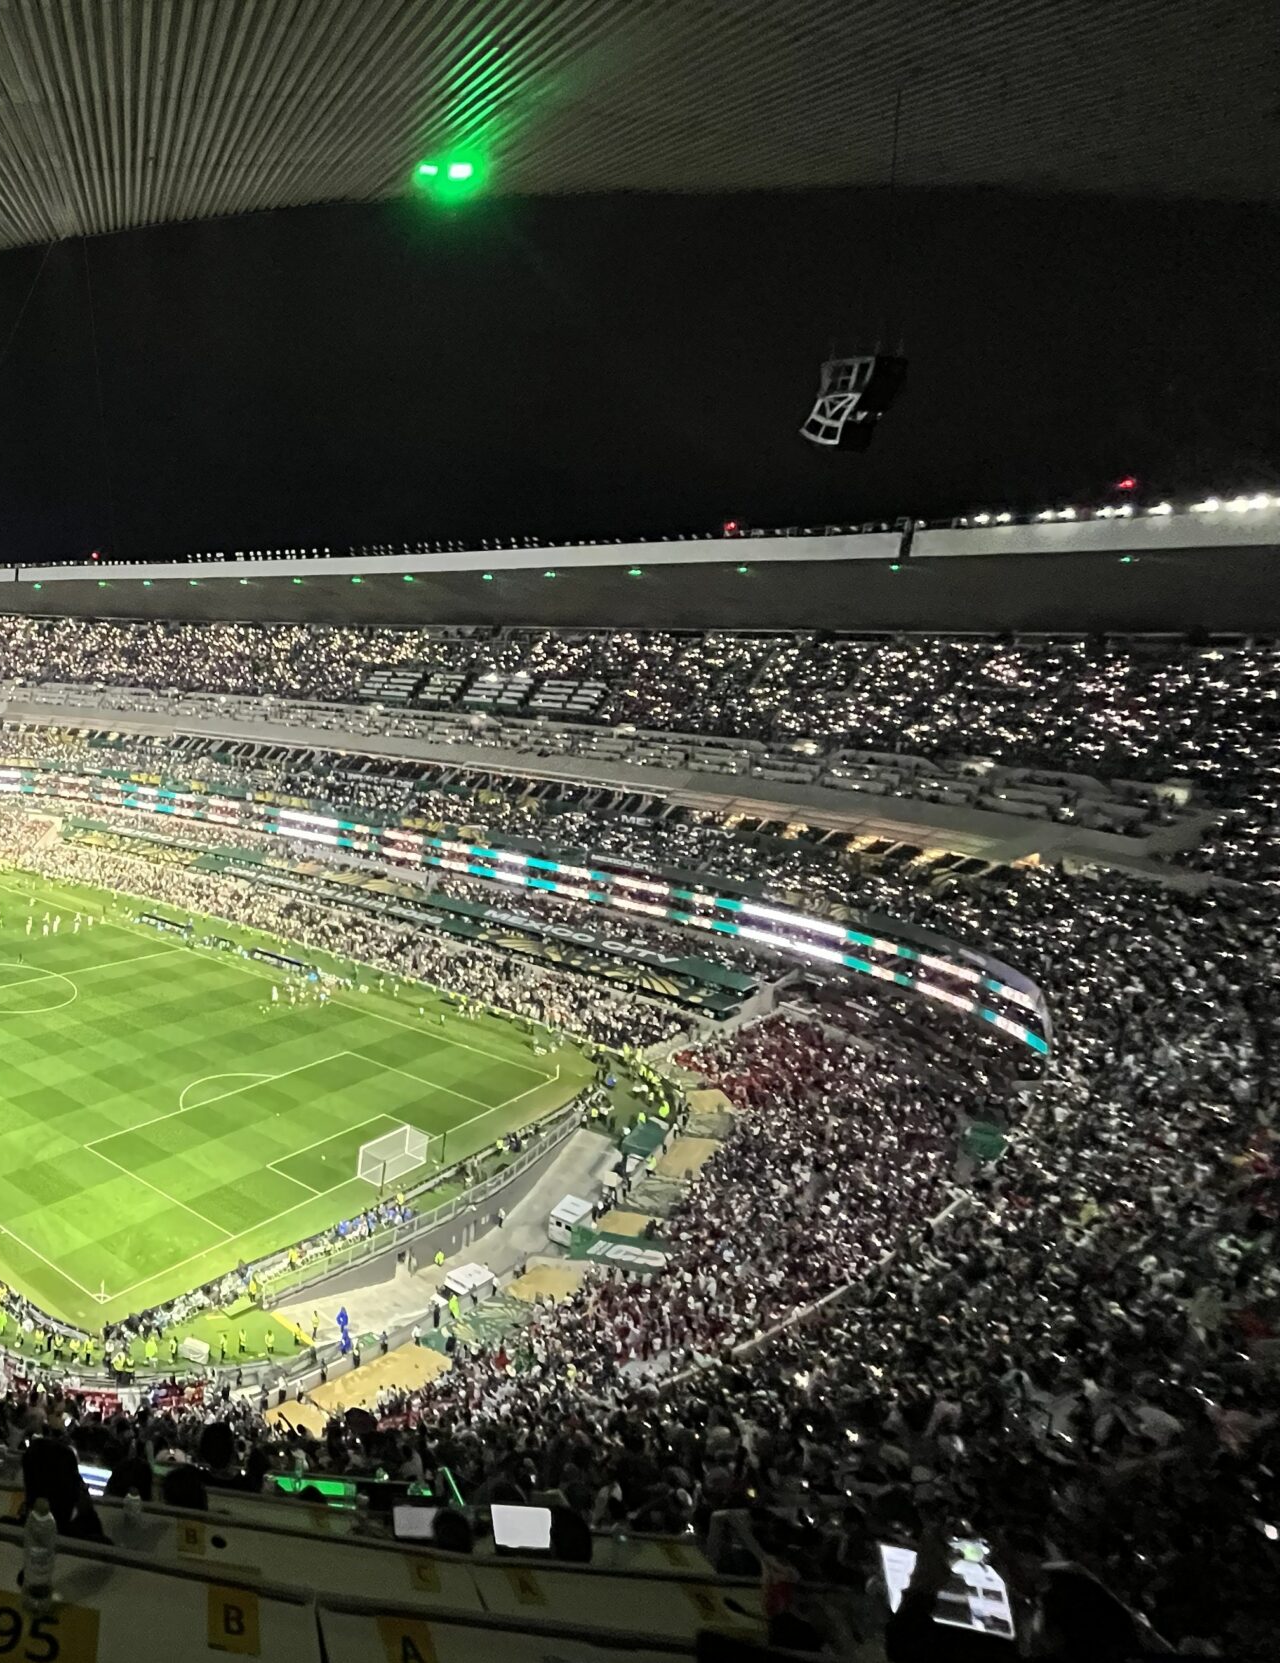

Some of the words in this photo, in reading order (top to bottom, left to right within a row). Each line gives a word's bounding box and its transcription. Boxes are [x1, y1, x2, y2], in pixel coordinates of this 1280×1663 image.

[483, 909, 595, 943] MEXICO
[601, 940, 680, 963] CITY
[185, 1529, 198, 1545] B
[223, 1604, 245, 1636] B
[400, 1635, 424, 1663] A
